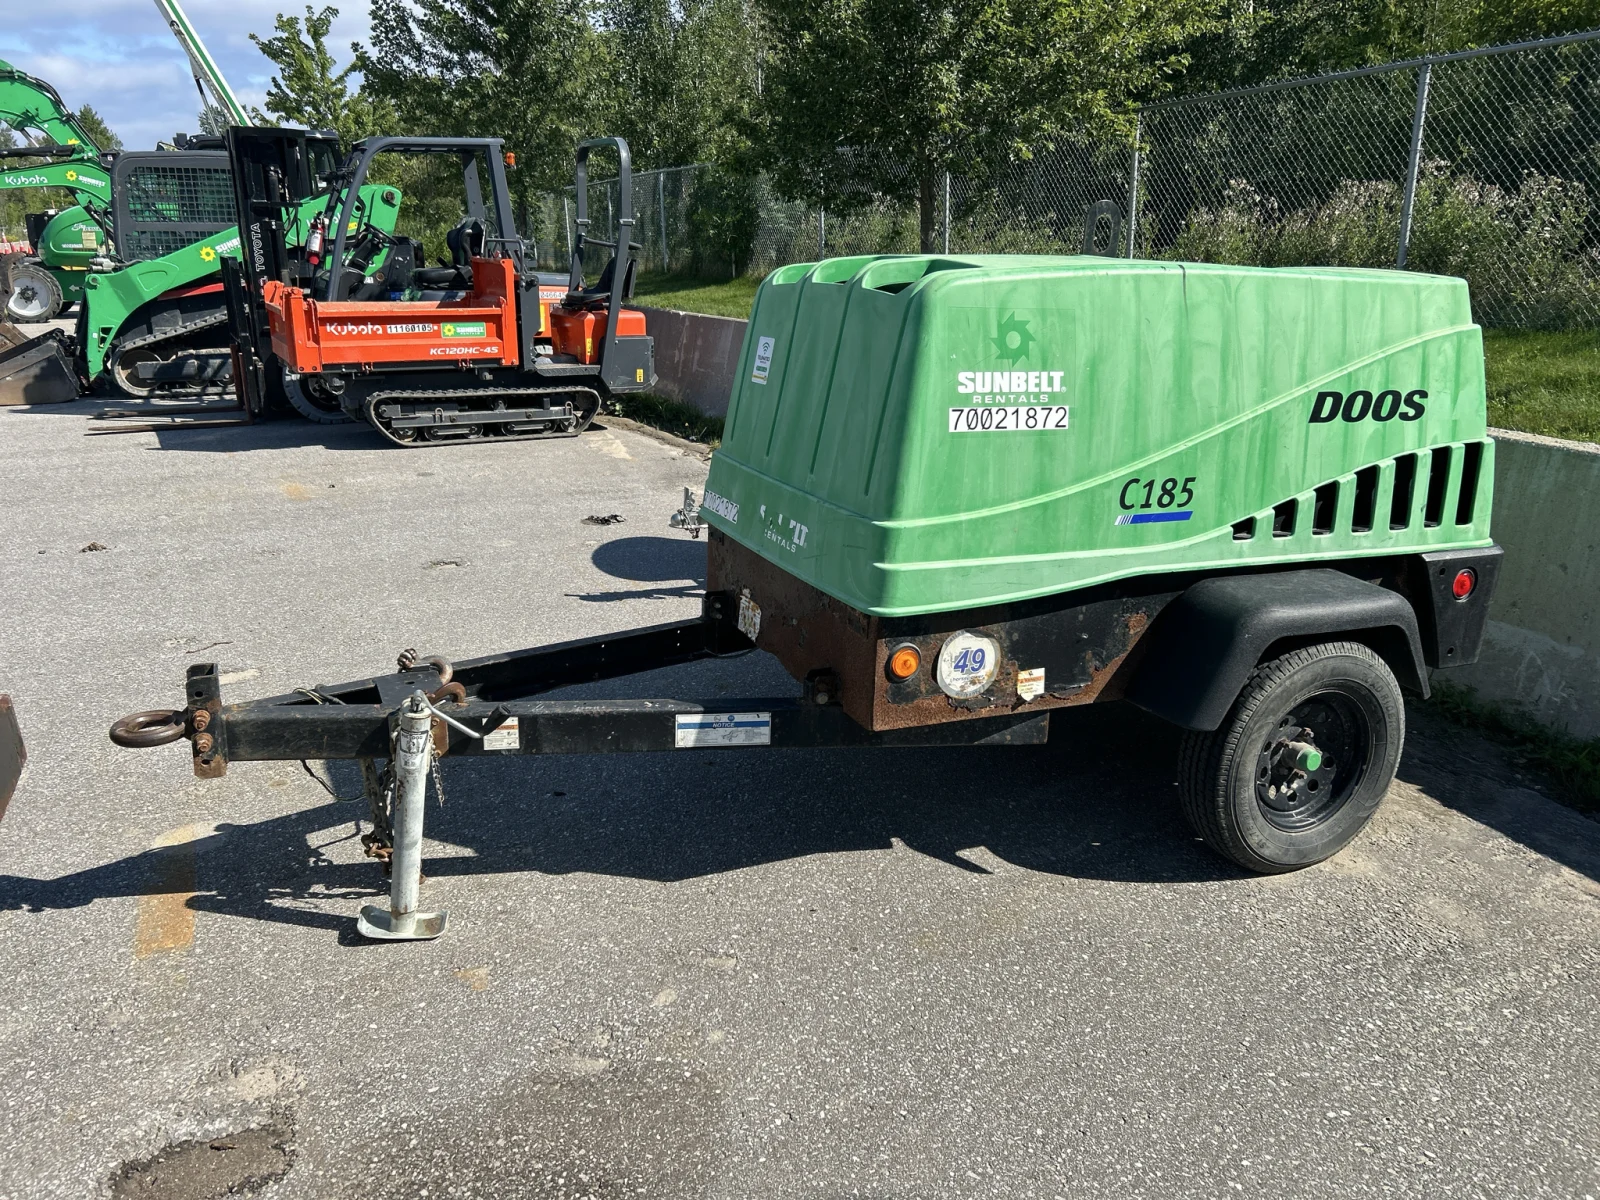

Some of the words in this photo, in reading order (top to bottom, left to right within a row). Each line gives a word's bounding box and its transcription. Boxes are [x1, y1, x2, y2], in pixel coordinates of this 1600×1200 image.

[5, 175, 48, 186] Kubota
[251, 222, 266, 272] TOYOTA
[326, 322, 383, 336] Kubota
[387, 324, 432, 334] 11160105
[957, 371, 1065, 394] SUNBELT
[973, 394, 1049, 403] RENTALS
[1308, 389, 1428, 423] DOOS
[951, 406, 1067, 430] 70021872
[1119, 476, 1196, 510] C185
[953, 647, 986, 674] 49
